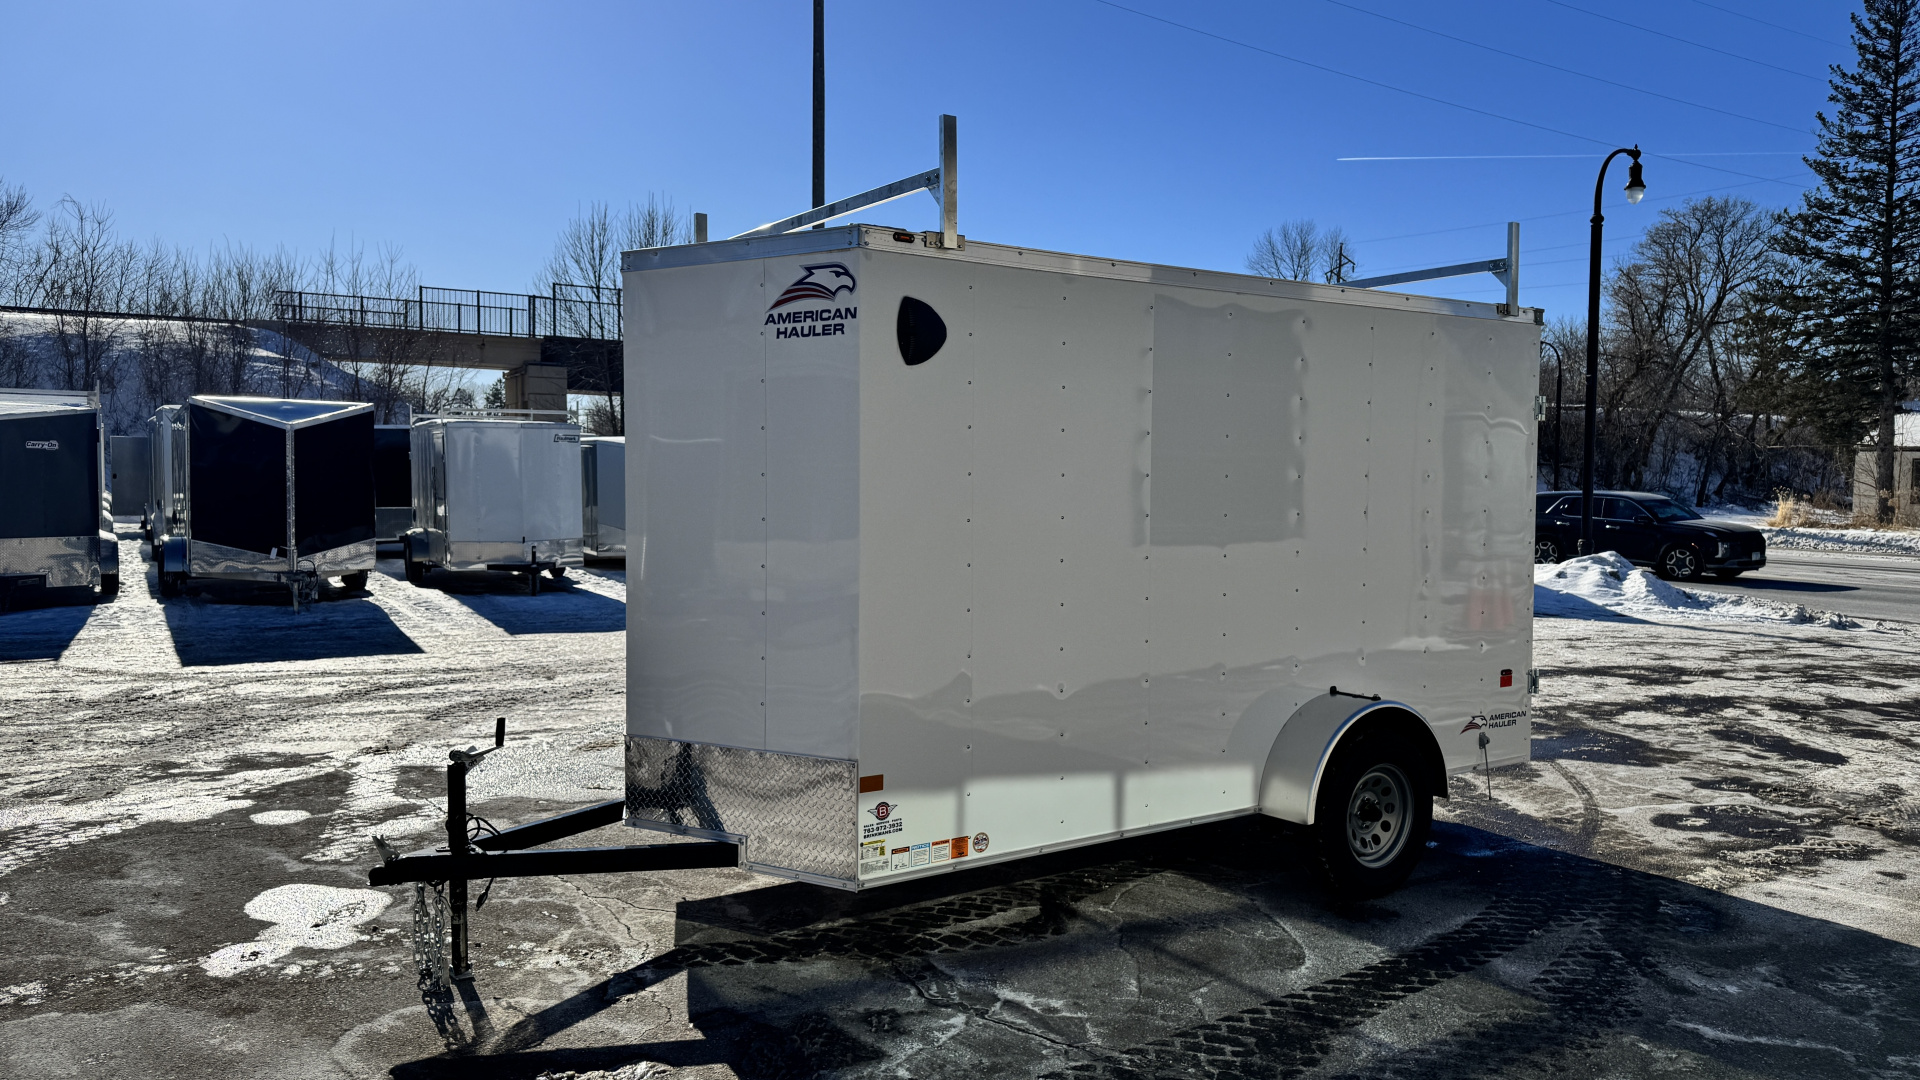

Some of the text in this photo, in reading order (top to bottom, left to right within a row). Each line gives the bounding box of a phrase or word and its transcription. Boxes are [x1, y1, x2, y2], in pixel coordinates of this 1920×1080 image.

[764, 307, 857, 325] AMERICAN
[776, 323, 845, 339] HAULER
[1489, 711, 1526, 721] AMERICAN
[1489, 720, 1516, 729] HAULER
[880, 806, 886, 816] B
